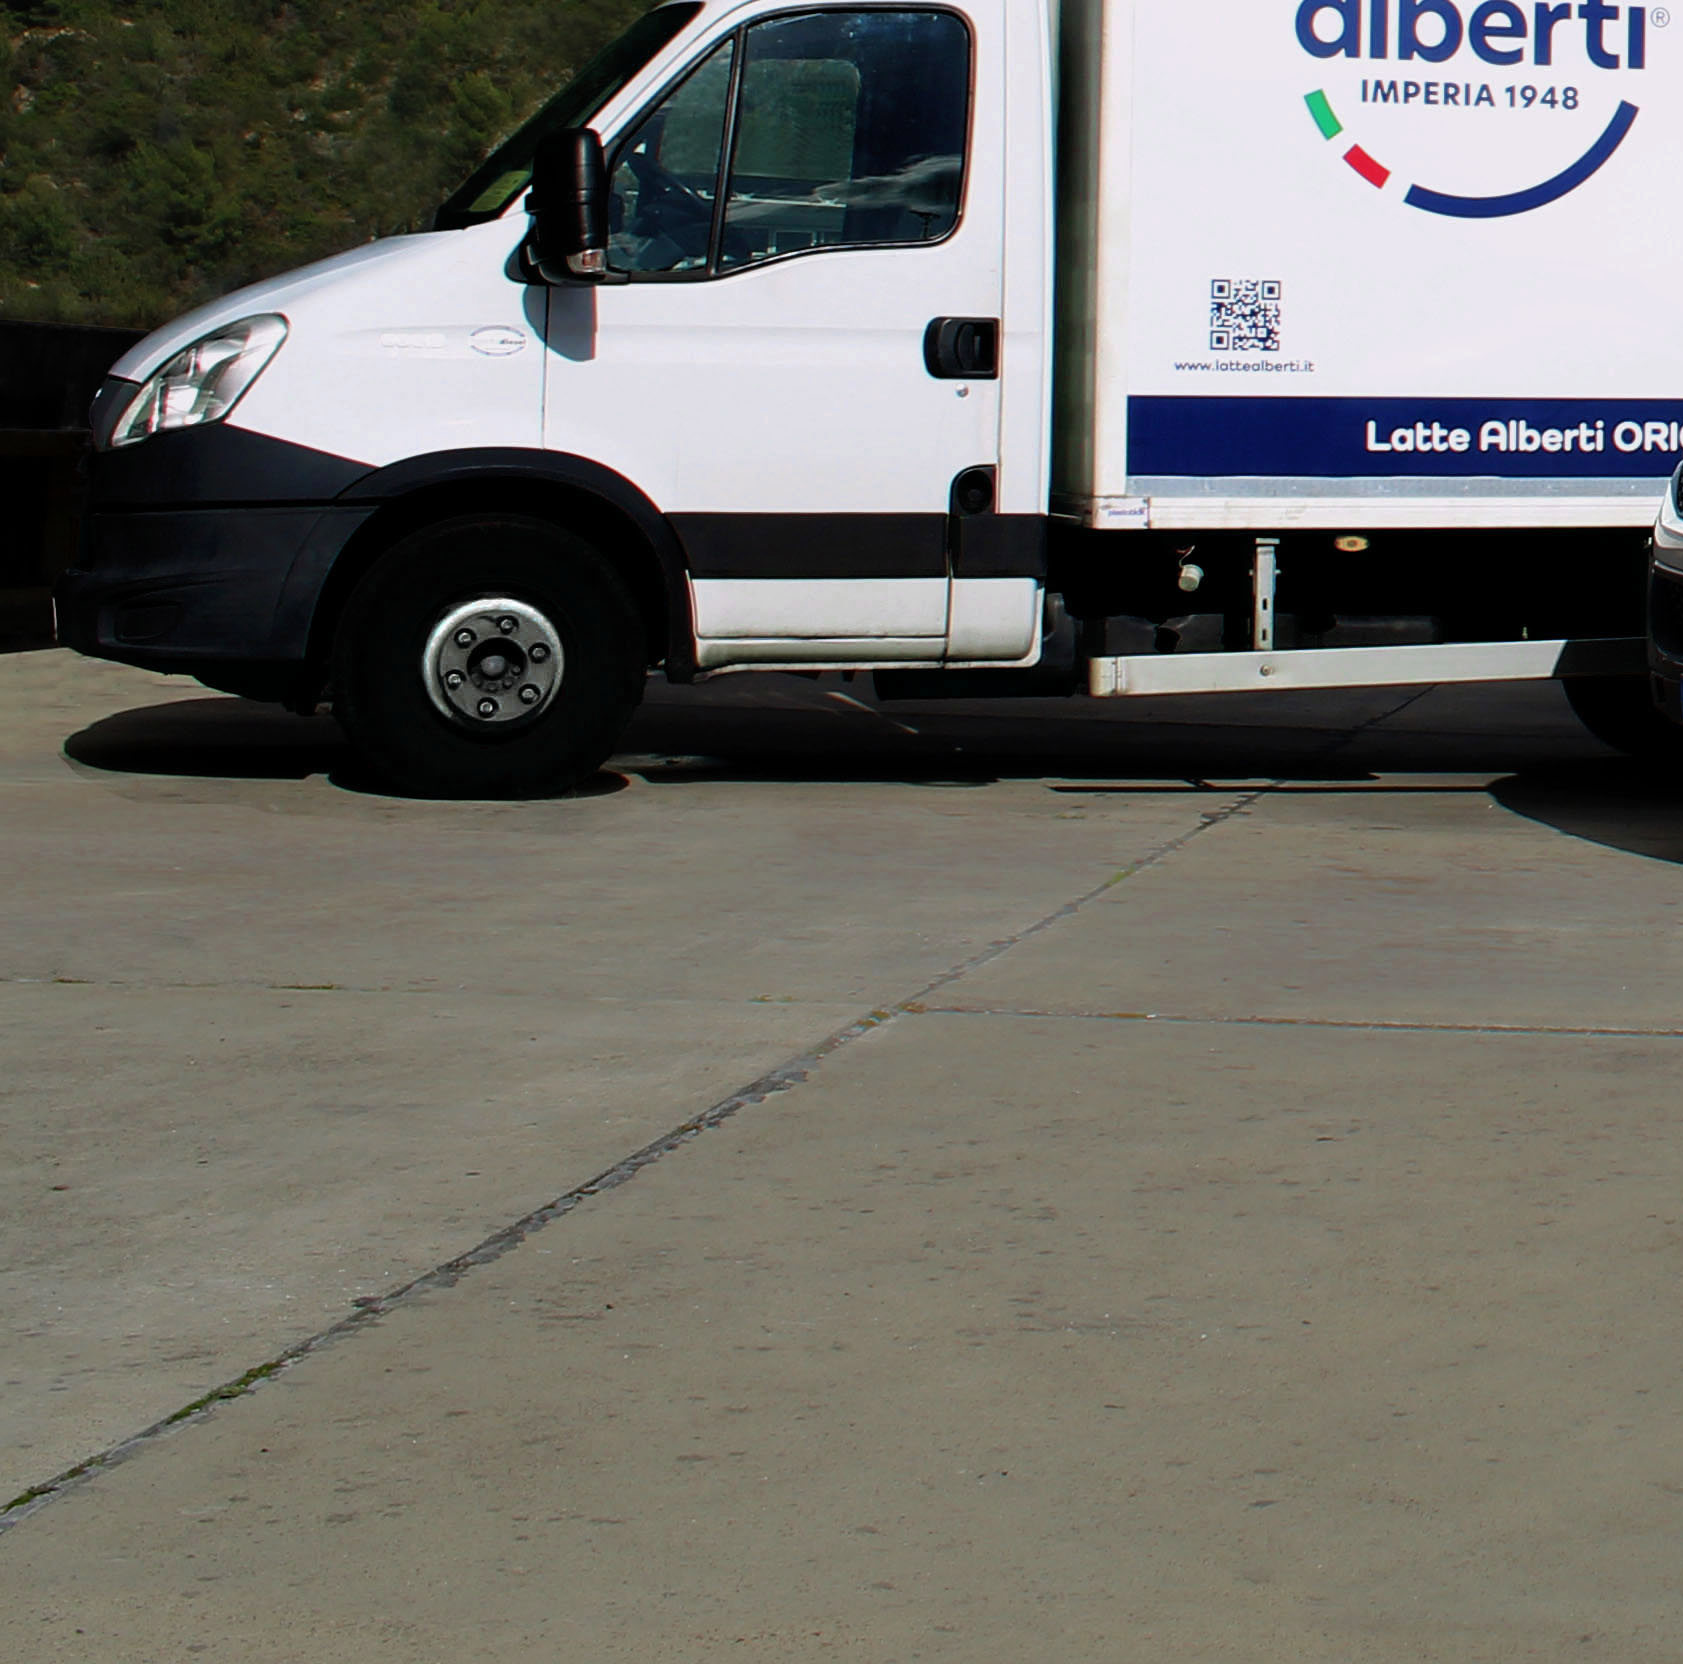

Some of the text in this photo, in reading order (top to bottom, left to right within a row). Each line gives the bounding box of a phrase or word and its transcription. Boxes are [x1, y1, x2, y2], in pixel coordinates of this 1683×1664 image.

[1361, 78, 1580, 111] IMPERIA 1948
[1174, 358, 1315, 374] www.lattealberti.it
[1367, 420, 1471, 453] Latte
[1479, 419, 1605, 453] Alberti
